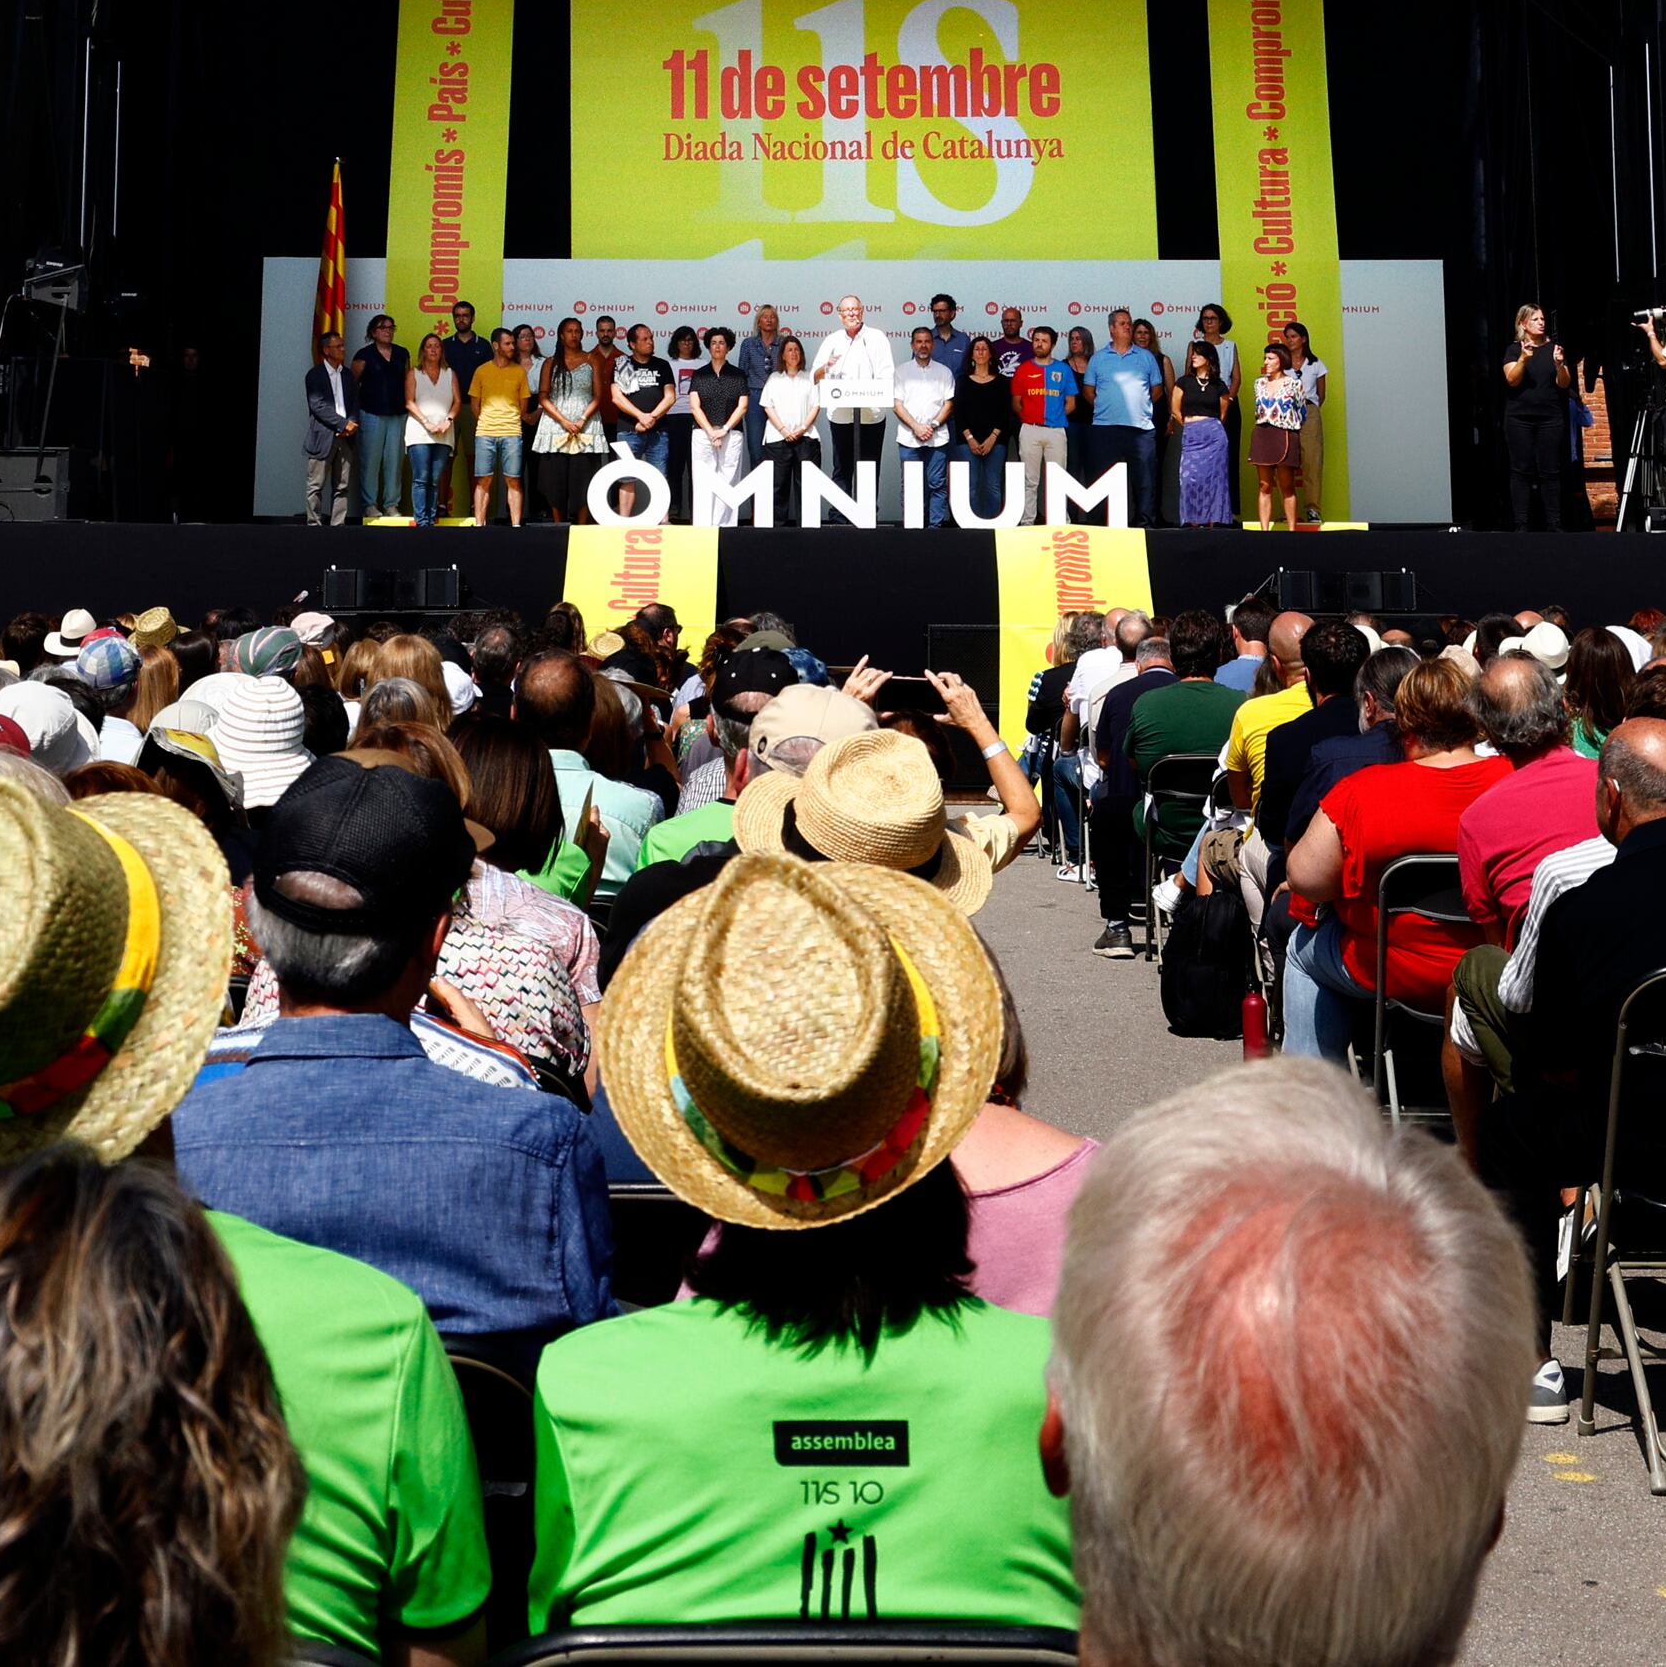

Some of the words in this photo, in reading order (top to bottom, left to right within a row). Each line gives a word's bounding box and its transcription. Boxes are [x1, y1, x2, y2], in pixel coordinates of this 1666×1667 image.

[428, 61, 470, 122] País
[663, 49, 709, 120] 11
[720, 49, 786, 120] de
[796, 47, 1062, 120] setembre
[663, 132, 743, 161] Diada
[752, 131, 873, 161] Nacional
[881, 131, 915, 161] de
[923, 130, 1064, 166] Catalunya
[419, 148, 470, 315] Compromís
[1252, 148, 1295, 255] Cultura
[508, 302, 553, 312] ÒMNIUM
[589, 303, 635, 312] ÒMNIUM
[671, 303, 717, 312] ÒMNIUM
[588, 440, 1130, 529] ÒMNIUM
[607, 529, 664, 612] Cultura
[790, 1431, 896, 1451] assemblea
